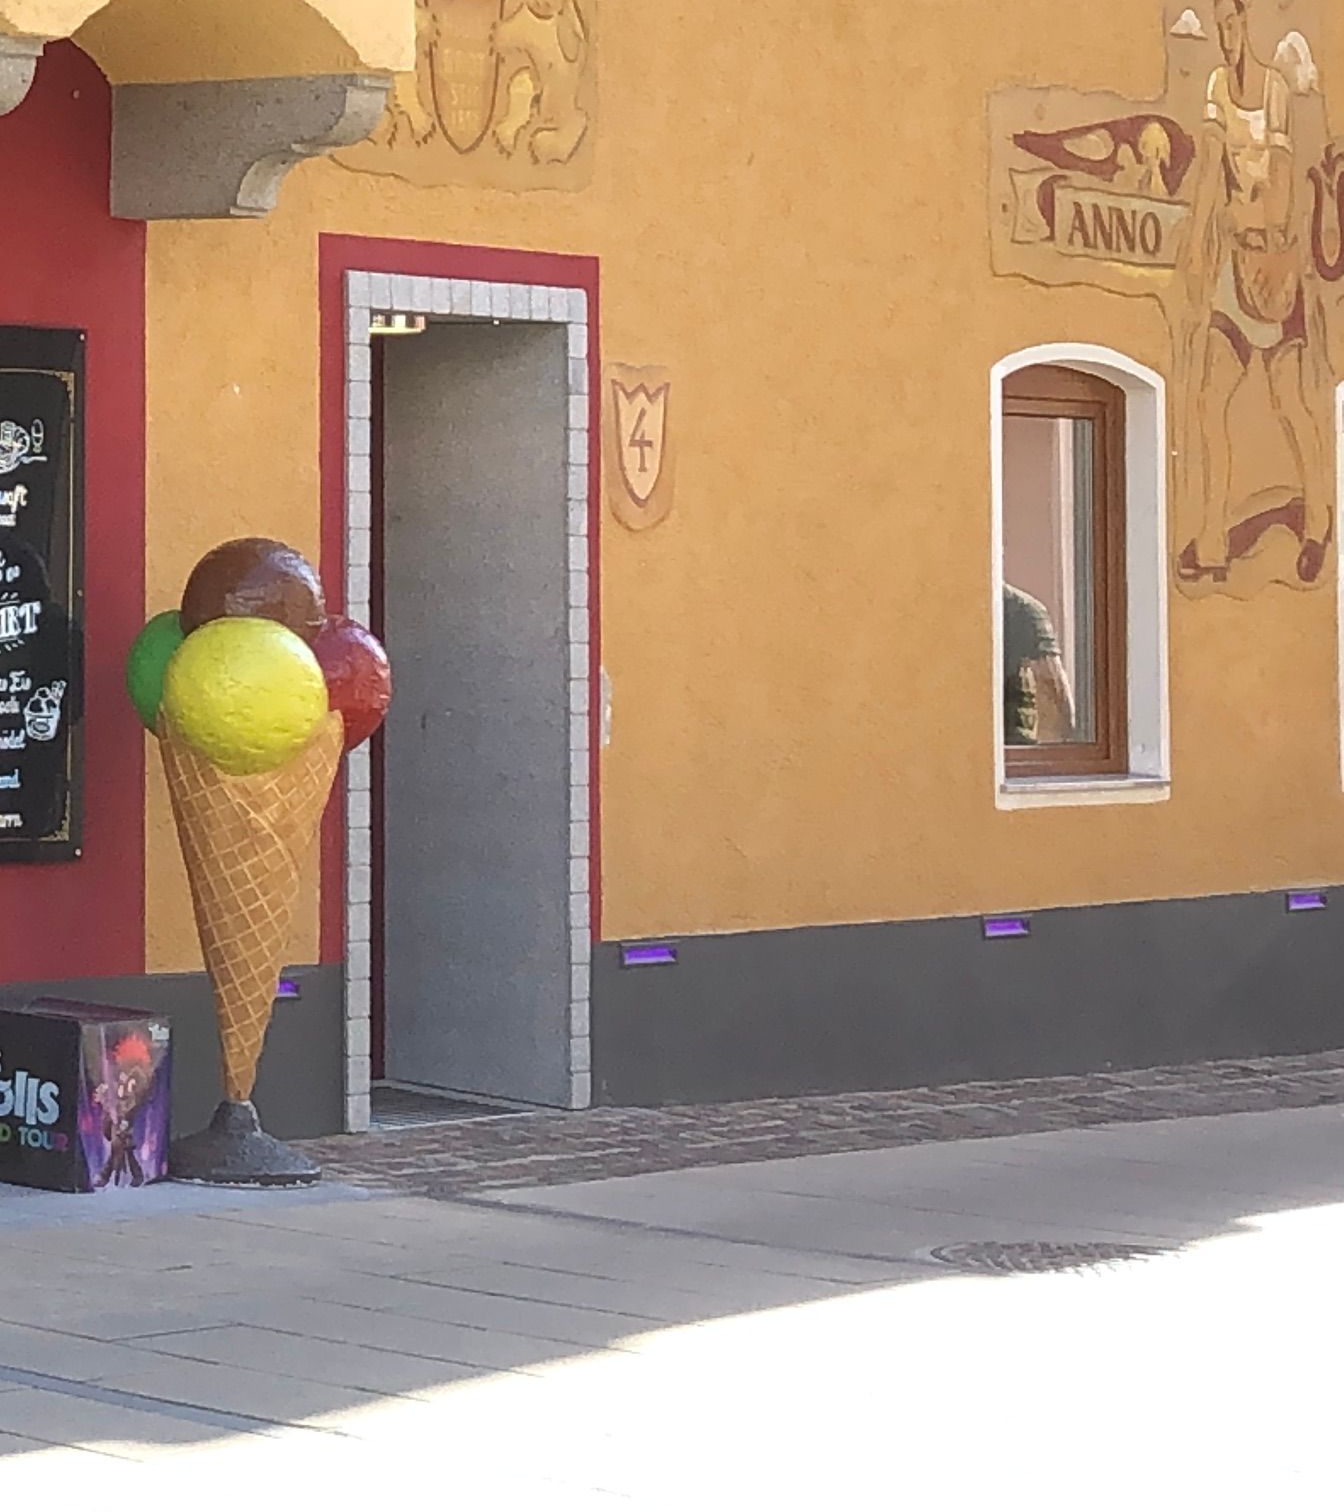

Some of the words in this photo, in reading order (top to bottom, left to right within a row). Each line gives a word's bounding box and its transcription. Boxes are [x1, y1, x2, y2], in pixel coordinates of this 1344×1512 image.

[1067, 200, 1162, 256] ANNO
[628, 407, 653, 473] 4
[18, 1127, 69, 1153] TOUR
